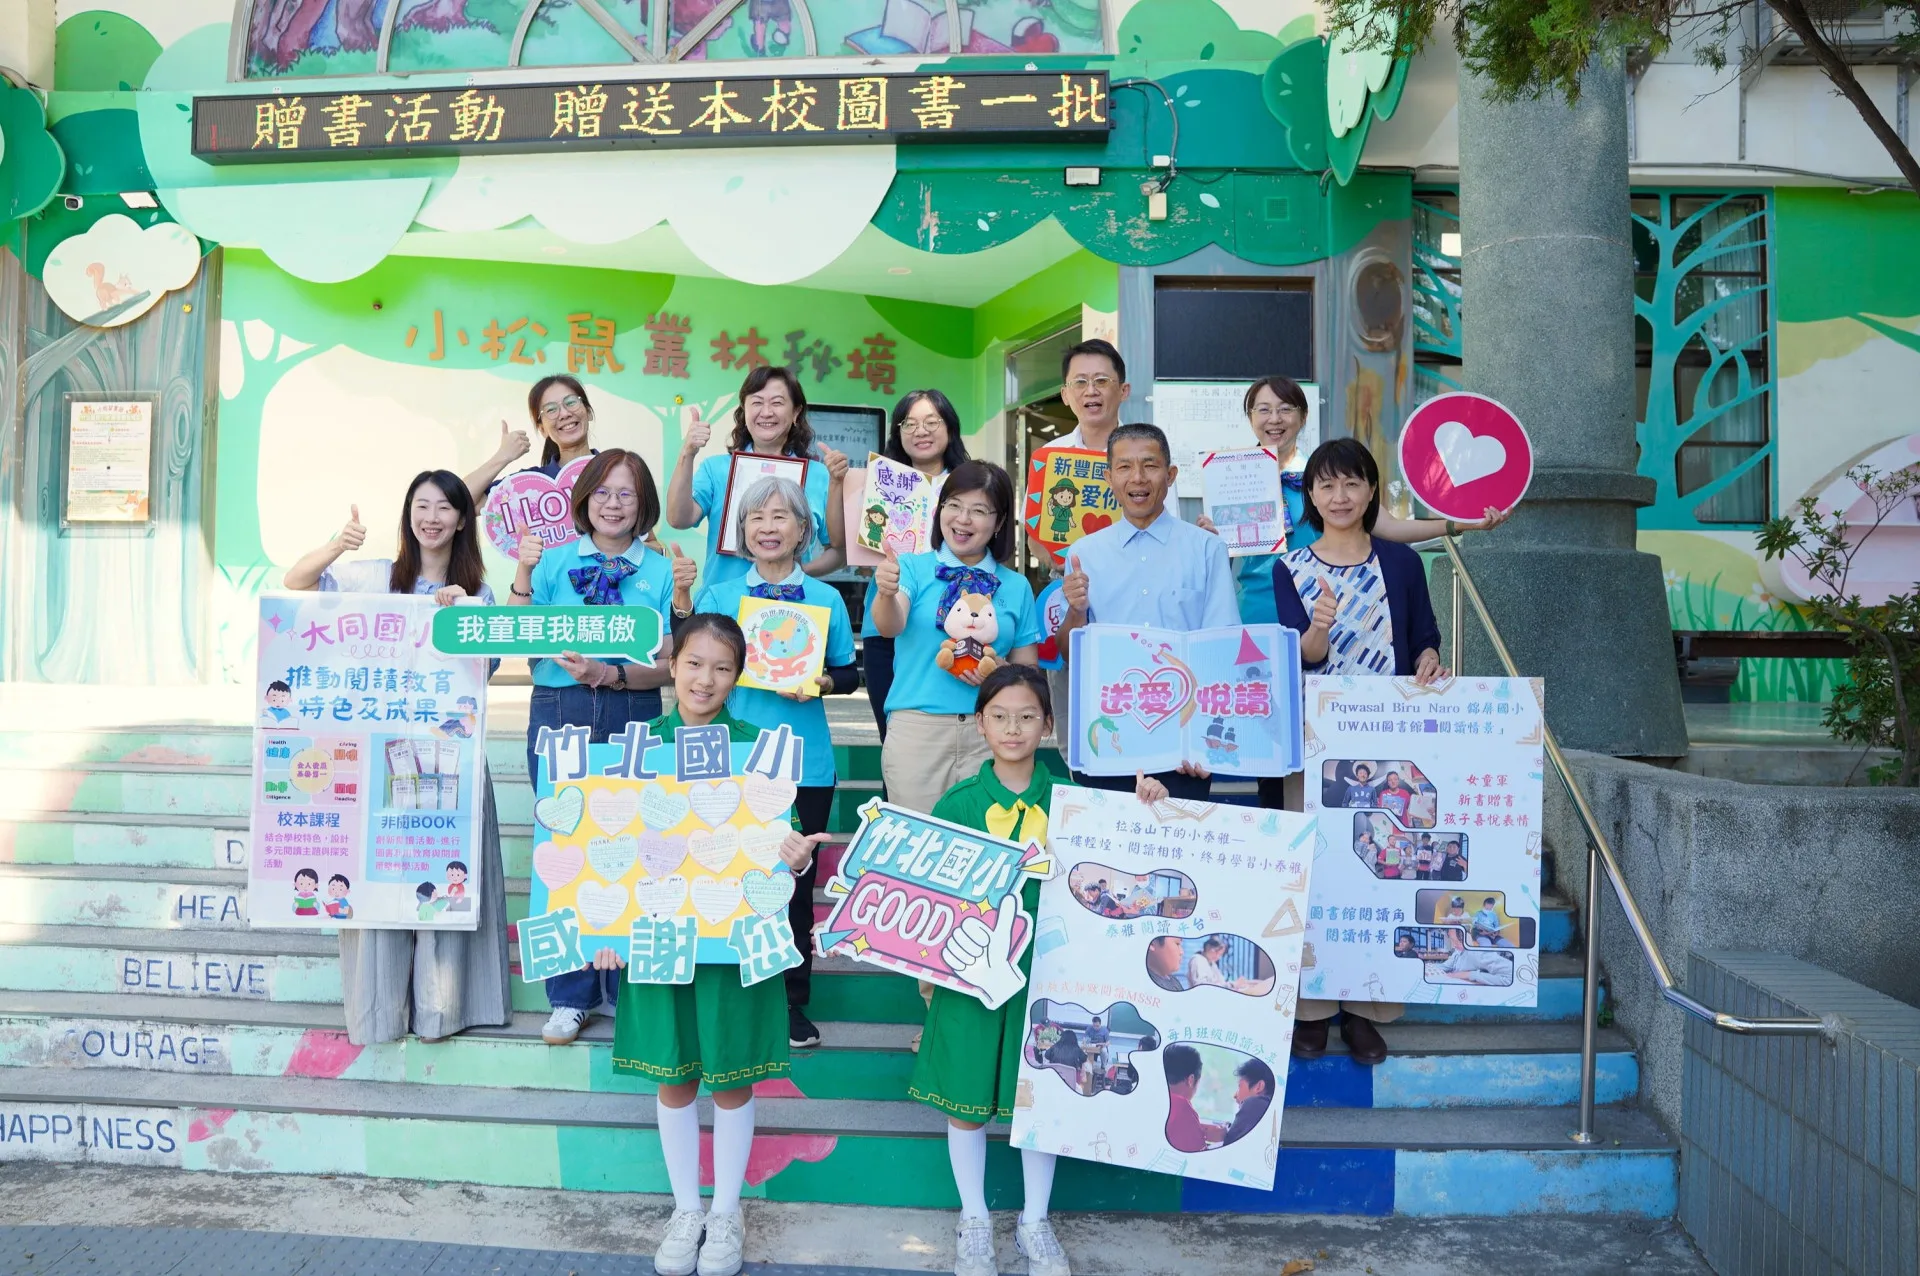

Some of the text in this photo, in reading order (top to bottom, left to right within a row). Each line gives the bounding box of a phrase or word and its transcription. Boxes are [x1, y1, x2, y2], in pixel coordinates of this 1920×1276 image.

[251, 75, 1107, 150] 贈書活動 贈送本校圖書一批
[404, 309, 898, 396] 小松鼠叢林秘境
[877, 465, 914, 492] 感謝
[1080, 484, 1122, 511] 愛你
[500, 502, 516, 534] I
[456, 614, 636, 645] 我童軍我驕傲
[285, 664, 456, 696] 推動閱讀教育
[298, 695, 440, 724] 特色及成果
[1100, 680, 1272, 717] 送愛 悅讀
[1392, 702, 1420, 713] Biru
[1428, 702, 1460, 714] Naro
[535, 722, 802, 783] 竹北國小
[1466, 773, 1508, 788] 女童軍
[1458, 793, 1515, 807] 新書贈書
[276, 811, 341, 828] 校本課程
[1443, 812, 1529, 827] 孩子喜悅表情
[263, 858, 283, 869] 活動
[860, 815, 1013, 898] 竹北國小
[178, 894, 250, 922] HEA
[850, 880, 956, 947] GOOD
[1310, 905, 1405, 923] 圖書館閱讀角
[518, 907, 803, 985] 感謝您
[1326, 927, 1389, 944] 閱讀情景
[123, 956, 265, 995] BELIEVE
